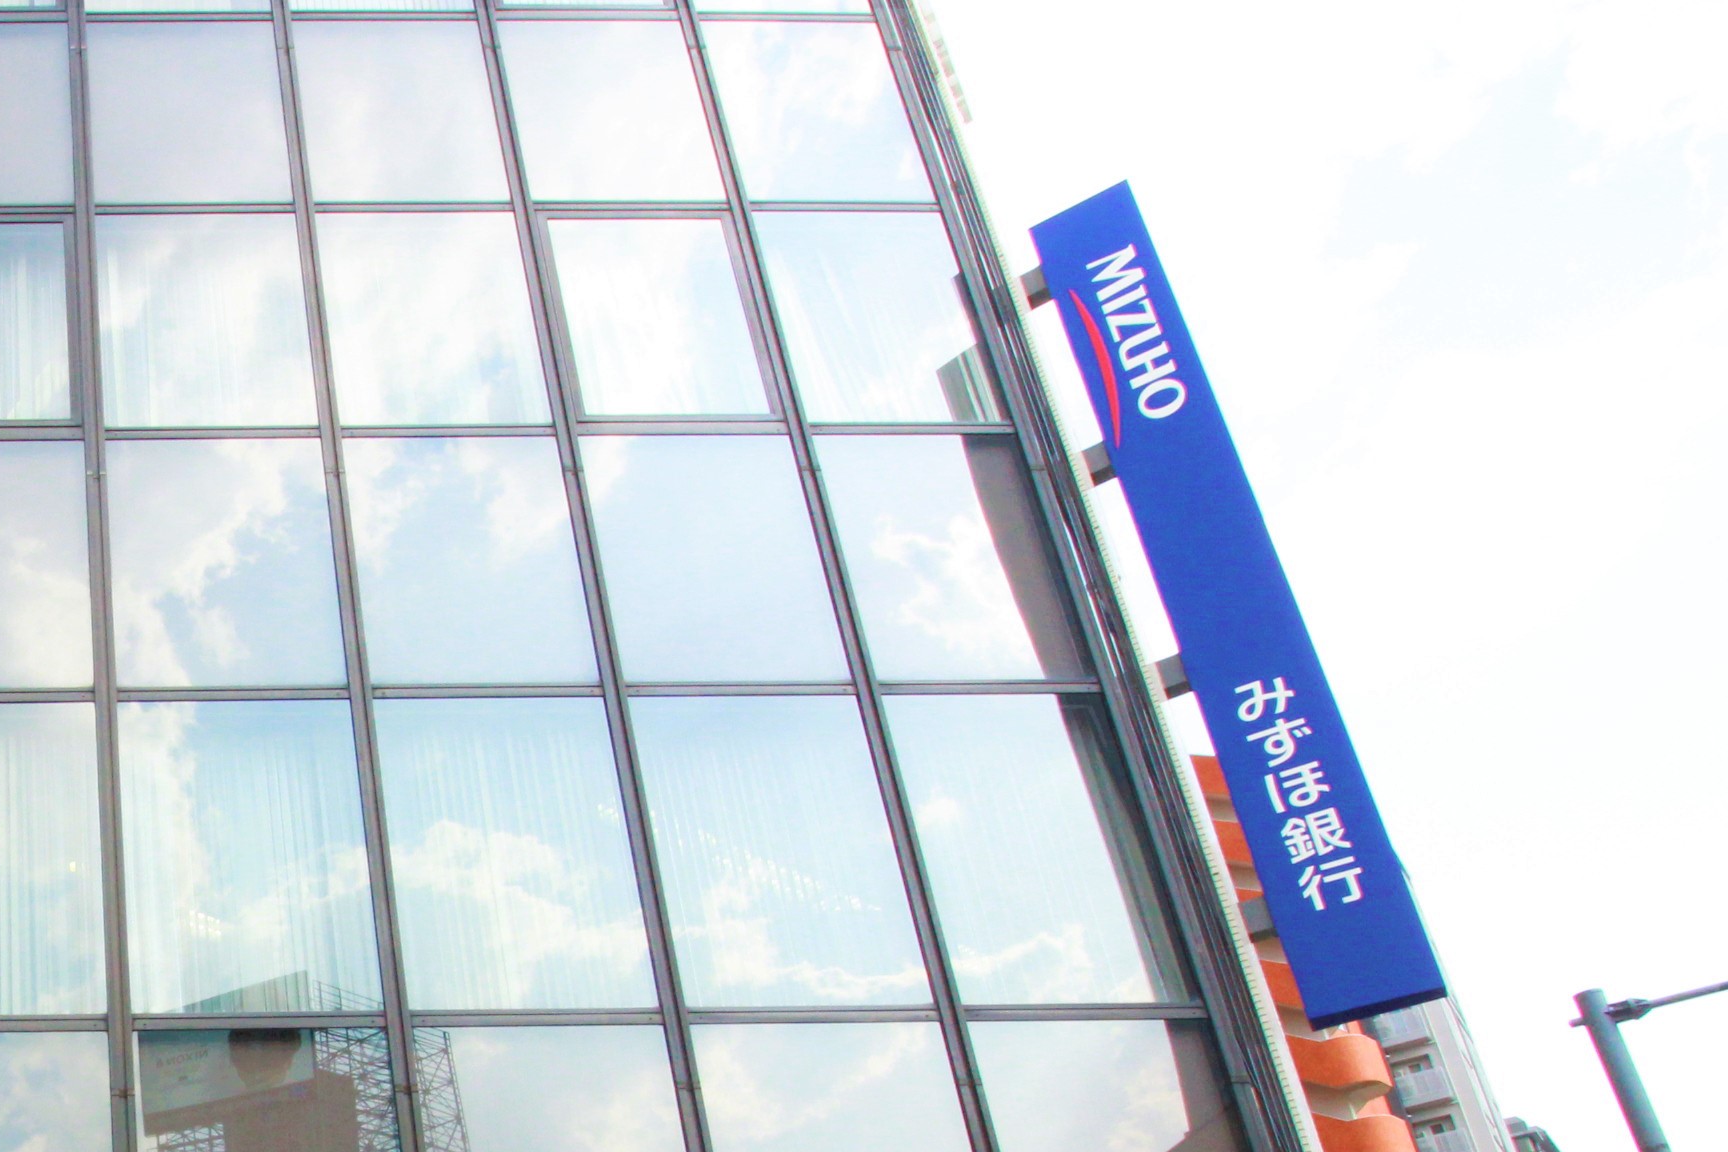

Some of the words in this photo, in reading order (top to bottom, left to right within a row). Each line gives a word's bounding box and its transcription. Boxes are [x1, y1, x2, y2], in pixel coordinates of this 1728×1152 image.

[1085, 243, 1187, 419] MIZUHO
[1234, 677, 1364, 911] みずほ銀行
